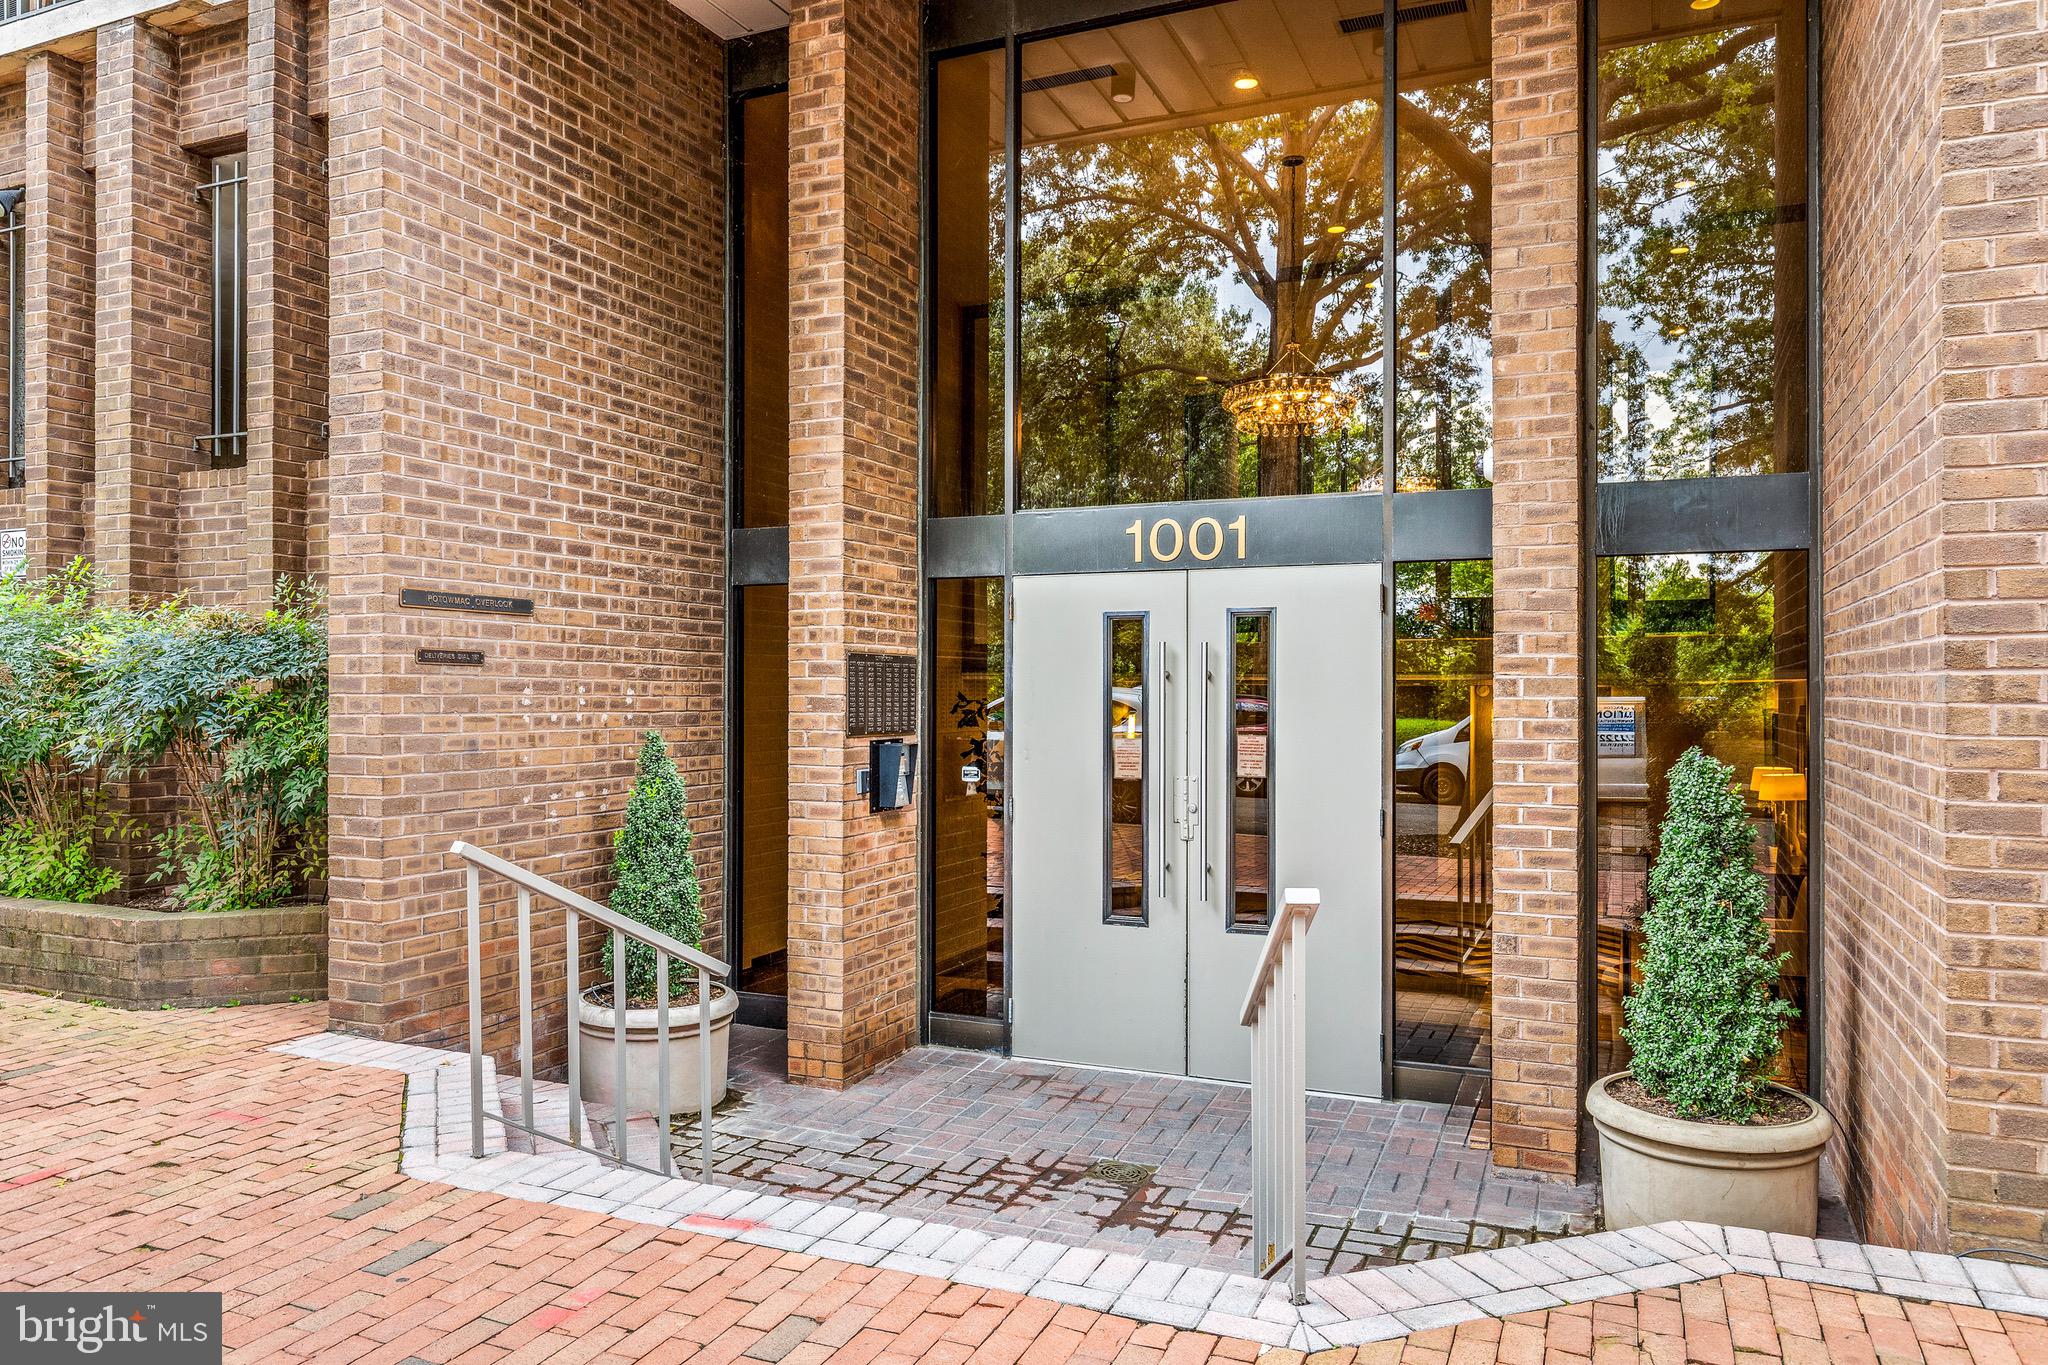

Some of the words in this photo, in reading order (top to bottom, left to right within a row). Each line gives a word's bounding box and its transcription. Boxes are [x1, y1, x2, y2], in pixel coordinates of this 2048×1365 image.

[11, 536, 24, 548] NO
[1125, 514, 1247, 563] 1001
[427, 594, 471, 605] POTOWMAC
[475, 598, 513, 608] OVERLOOK
